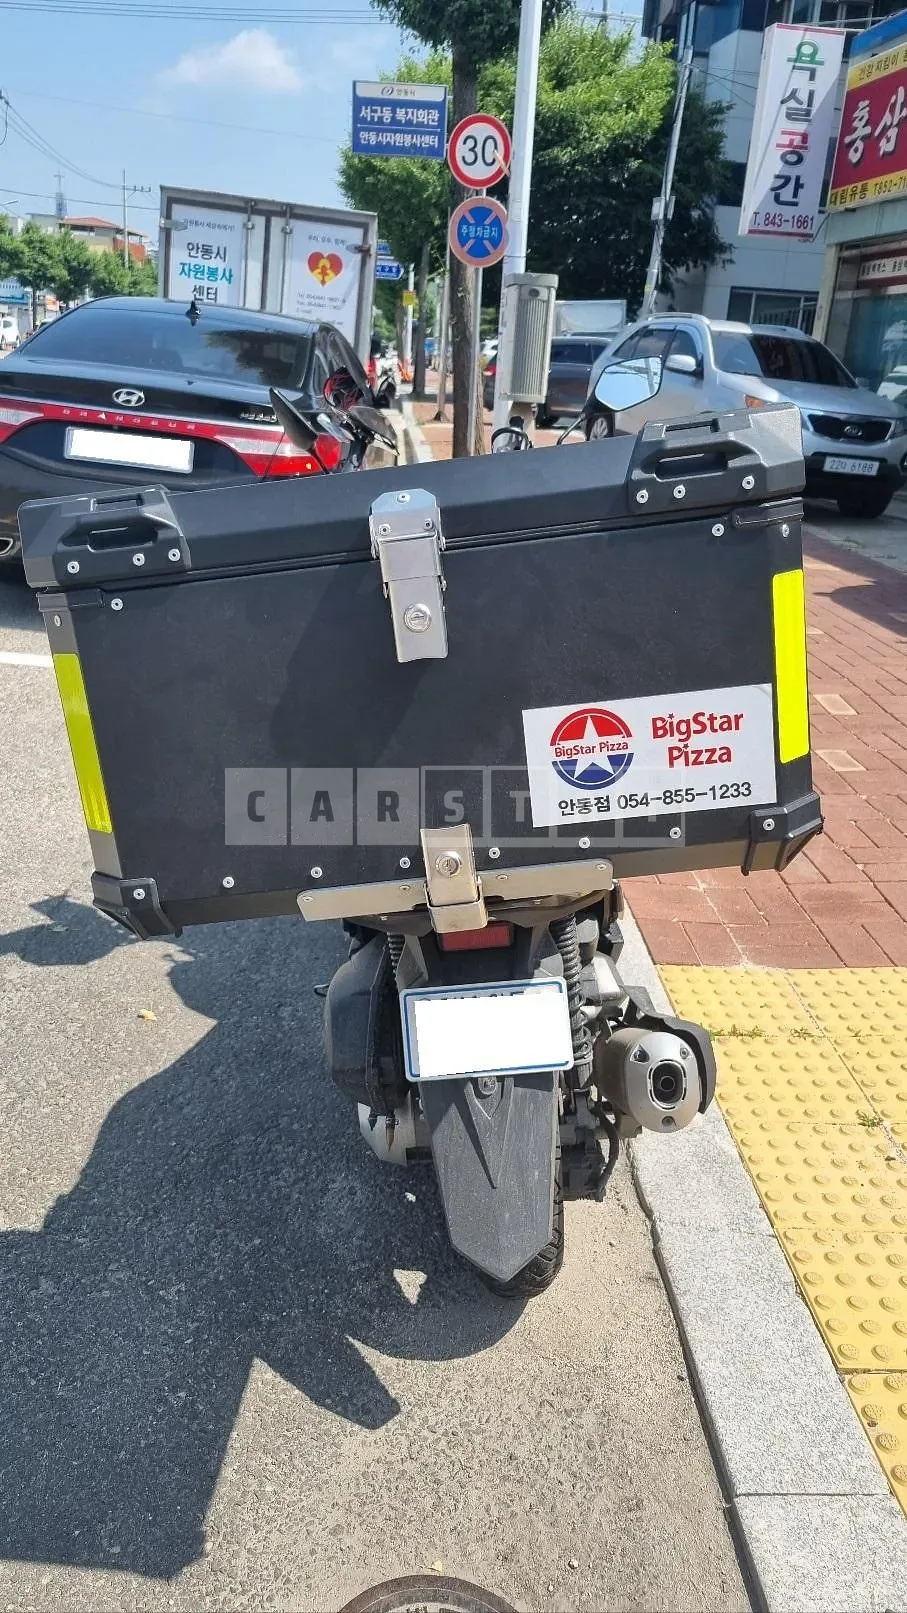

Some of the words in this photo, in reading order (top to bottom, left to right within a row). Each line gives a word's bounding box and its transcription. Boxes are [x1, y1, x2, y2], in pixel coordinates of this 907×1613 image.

[360, 105, 393, 123] 서구동
[395, 107, 440, 125] 복지회관
[770, 39, 825, 207] 욕실공간
[844, 85, 907, 164] 홍삼
[359, 131, 439, 148] 안동시자원봉사센터
[461, 134, 499, 167] 30
[830, 182, 868, 206] 대림유통
[461, 224, 498, 240] 주정차금지
[763, 212, 814, 230] 843-1661
[186, 241, 227, 263] 안동시
[179, 262, 233, 284] 자원봉사
[192, 284, 218, 303] 센터
[652, 712, 744, 742] BigStar
[554, 743, 596, 758] BigStar
[599, 741, 629, 753] Pizza
[667, 743, 732, 768] Pizza
[558, 795, 611, 816] 안동점
[617, 781, 752, 809] 054-855-1233
